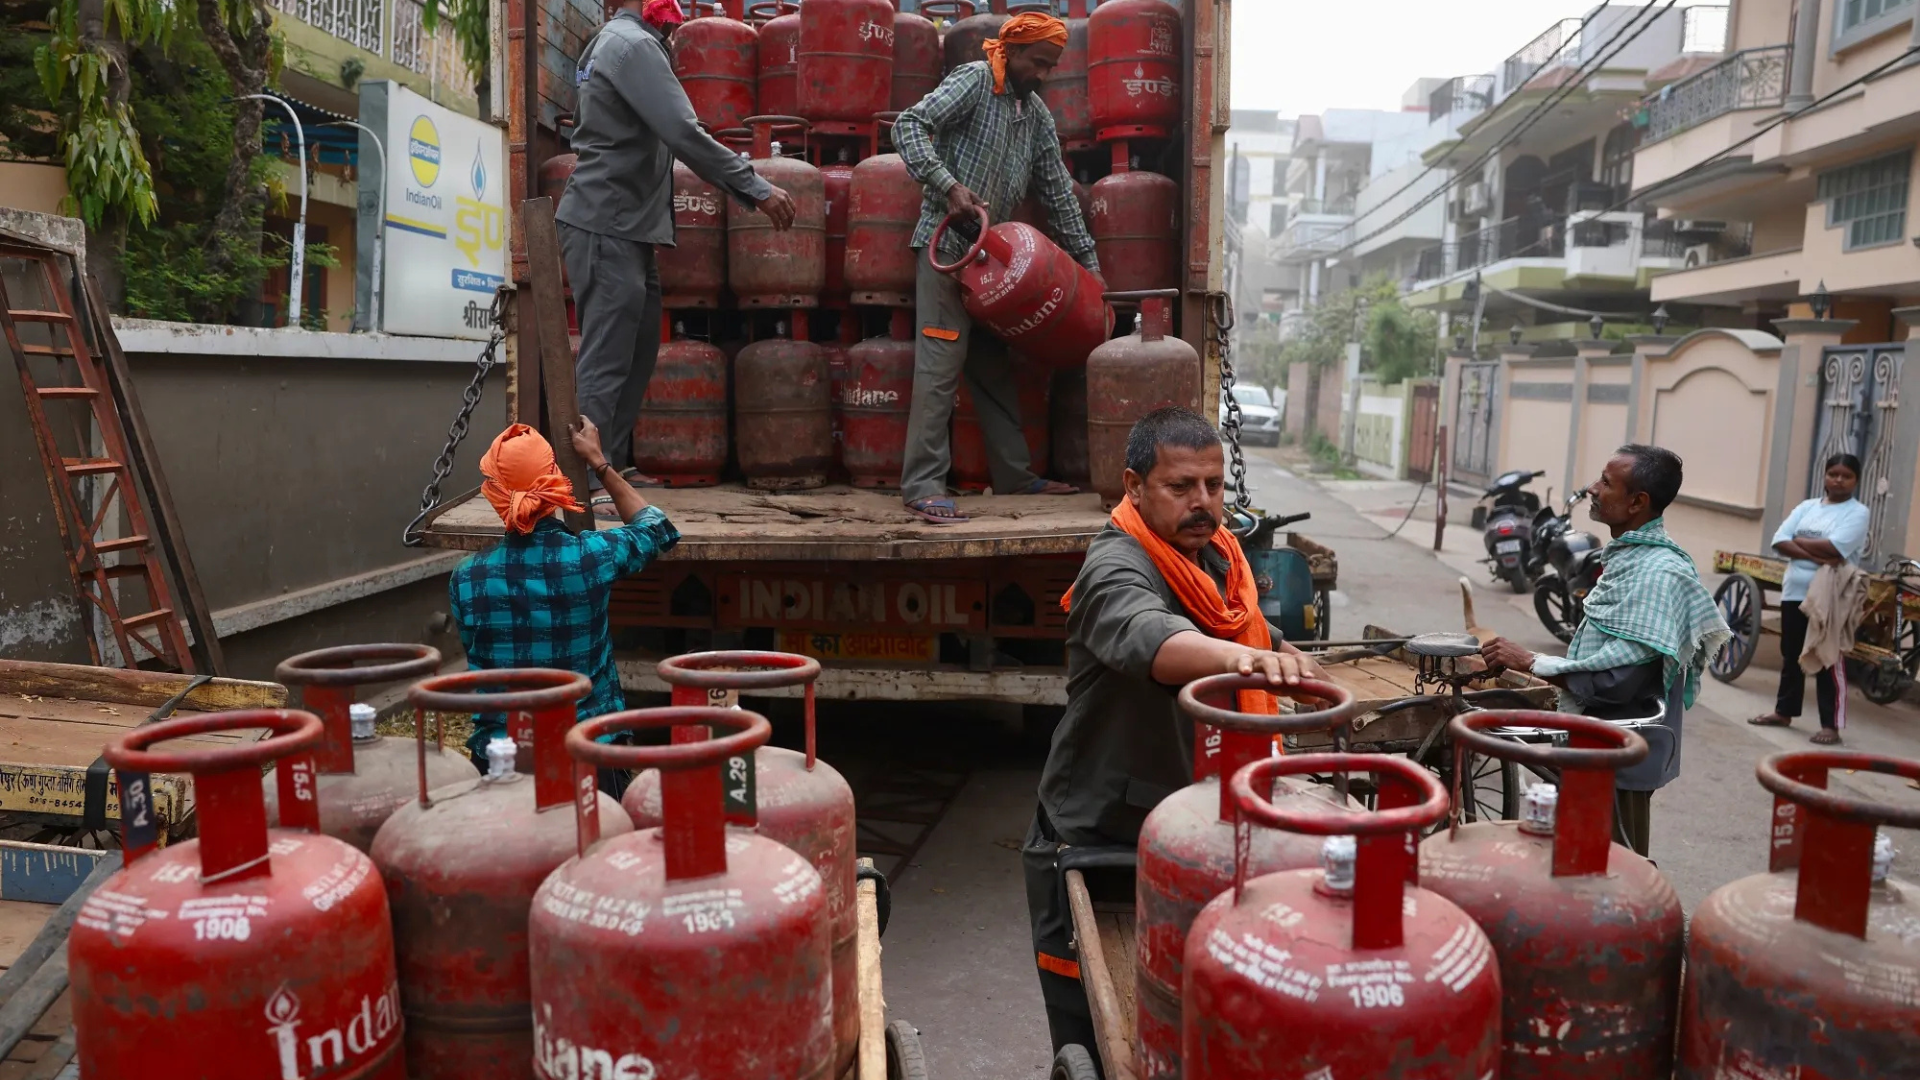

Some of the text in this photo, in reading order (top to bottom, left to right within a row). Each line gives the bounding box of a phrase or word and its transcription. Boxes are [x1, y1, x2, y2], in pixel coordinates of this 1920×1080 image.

[405, 187, 442, 210] IndianOil
[739, 578, 970, 625] INDIAN OIL
[291, 760, 313, 802] 15.5
[729, 755, 748, 804] A.29
[129, 778, 149, 827] A.30
[1347, 982, 1405, 1009] 1906
